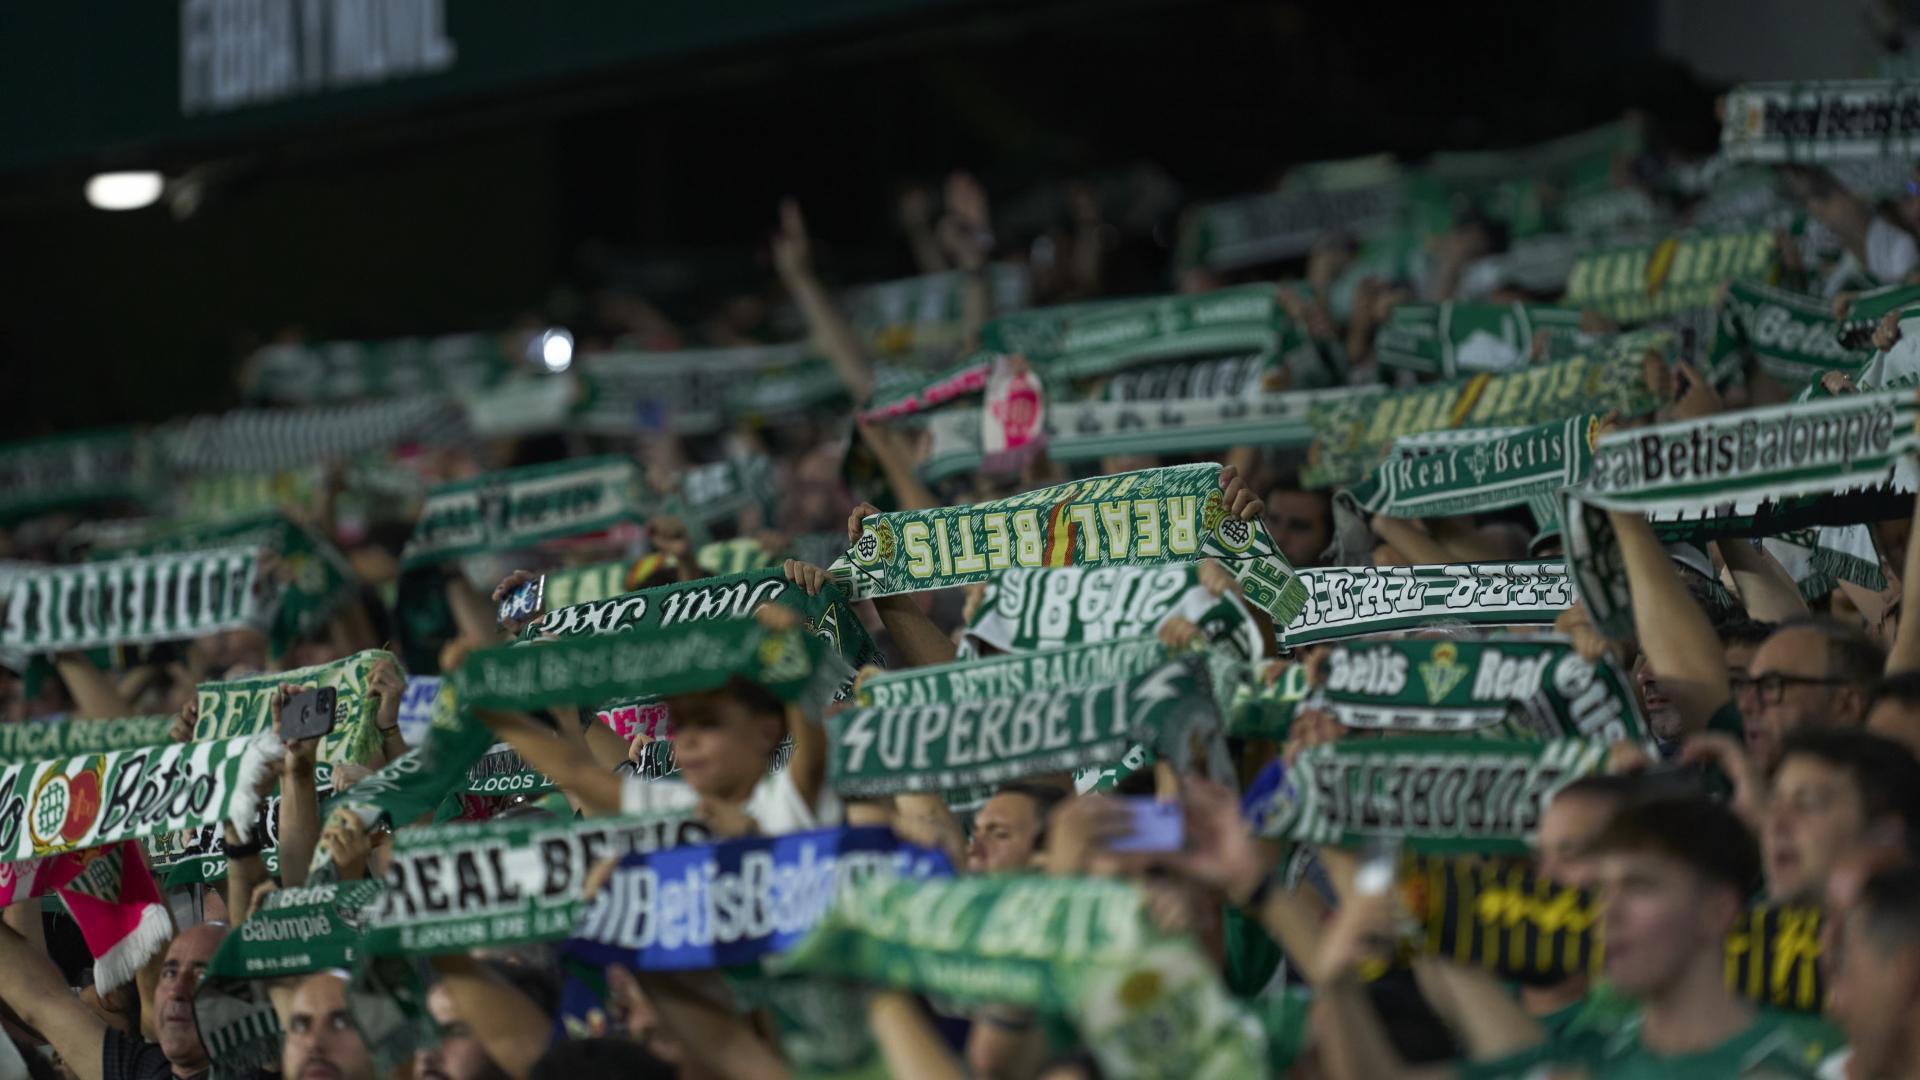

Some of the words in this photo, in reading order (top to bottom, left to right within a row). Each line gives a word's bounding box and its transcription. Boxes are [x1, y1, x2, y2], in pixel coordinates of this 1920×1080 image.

[1471, 354, 1590, 422] BETIS
[1399, 449, 1459, 493] Real
[1493, 427, 1563, 474] Betis
[1590, 402, 1895, 488] ealBetisBalompié
[902, 507, 1043, 579] BETIS
[1069, 496, 1198, 563] REAL
[1288, 566, 1427, 630] REAL
[1444, 564, 1576, 608] BETI
[948, 658, 1028, 704] BETIS
[1326, 645, 1410, 697] Betis
[1471, 648, 1555, 701] Real
[469, 774, 535, 792] LOCOS
[381, 846, 521, 918] REAL
